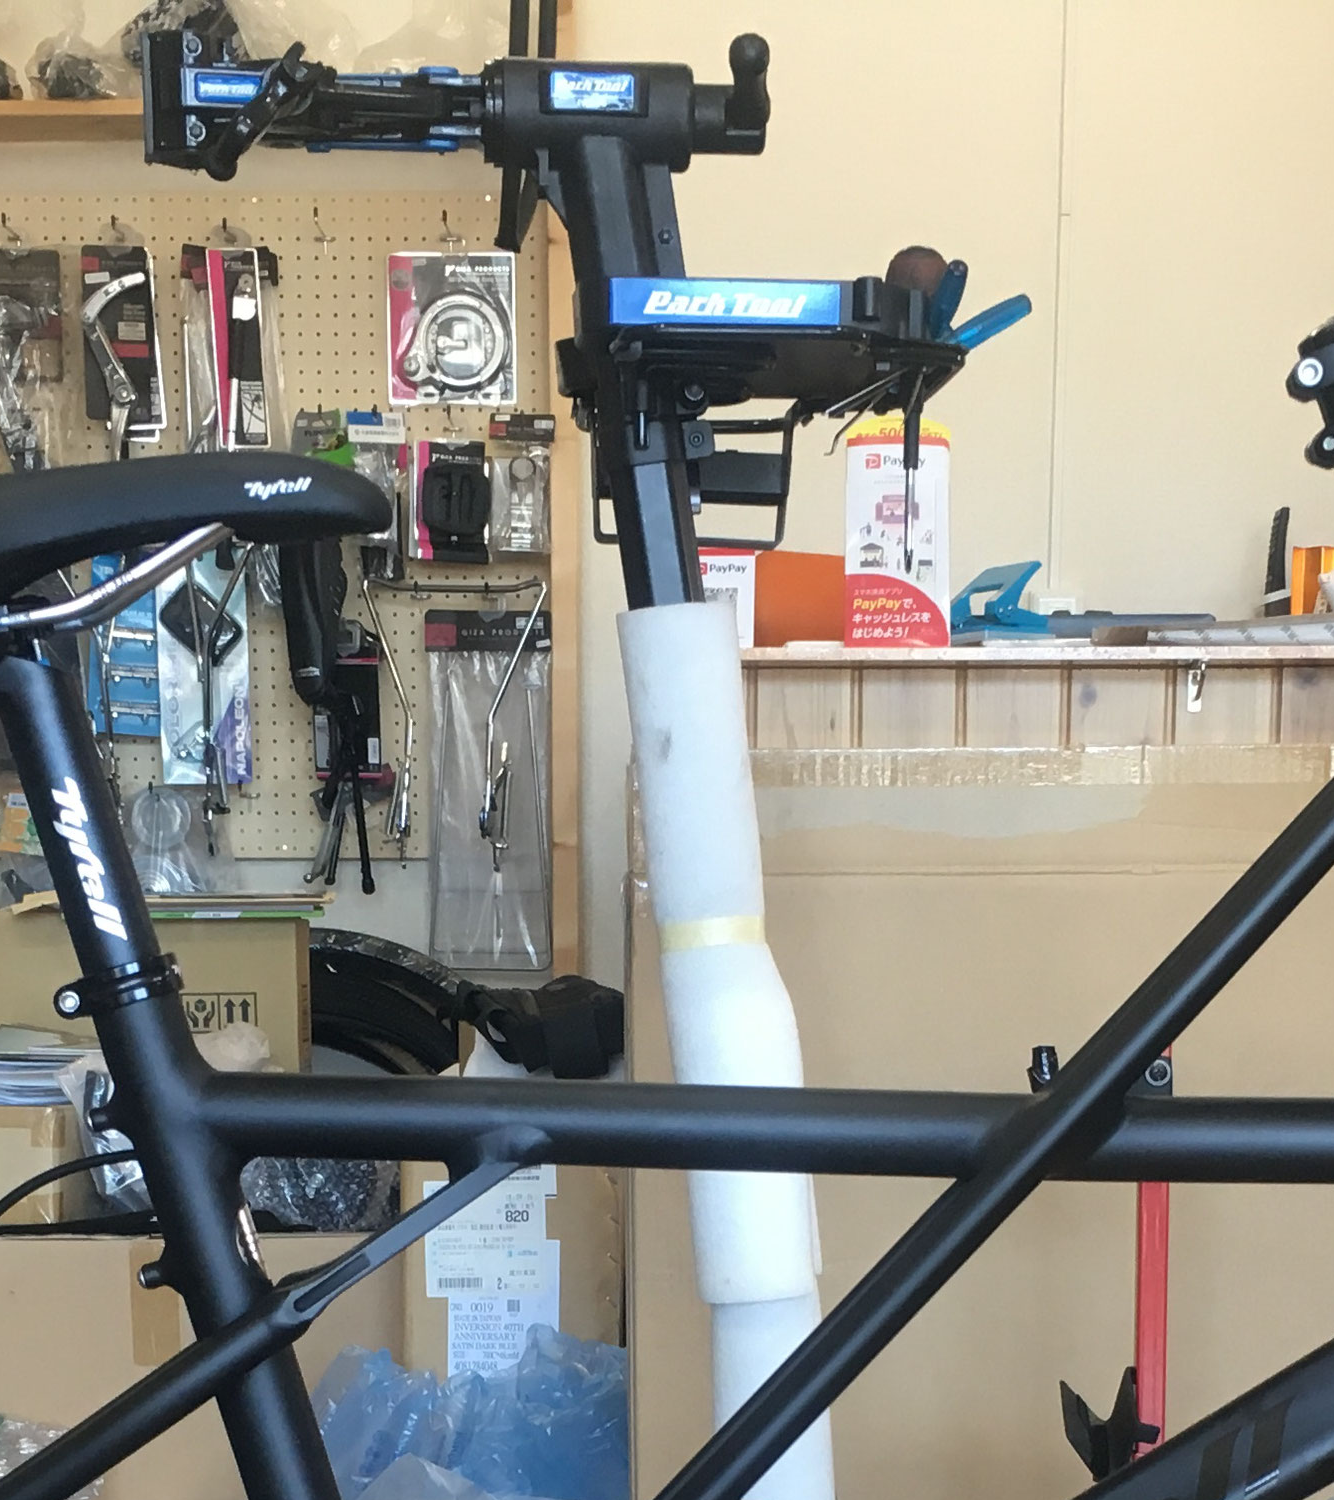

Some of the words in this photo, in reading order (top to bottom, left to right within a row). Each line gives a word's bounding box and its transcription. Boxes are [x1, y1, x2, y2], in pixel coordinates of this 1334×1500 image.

[643, 290, 727, 315] Park
[730, 293, 807, 318] Tool
[244, 477, 312, 500] Tyrell
[709, 563, 747, 574] PayPay
[852, 613, 931, 624] キャッシュレスを
[461, 628, 485, 636] GIZA
[234, 684, 247, 774] NAPOLEON
[48, 778, 129, 941] Tyrell
[505, 1210, 529, 1223] 820
[496, 1277, 503, 1290] 2
[470, 1302, 494, 1313] 0019
[454, 1323, 501, 1331] INVERSION
[503, 1323, 524, 1331] 40TH
[452, 1342, 474, 1350] SATIN
[475, 1342, 496, 1350] DARK
